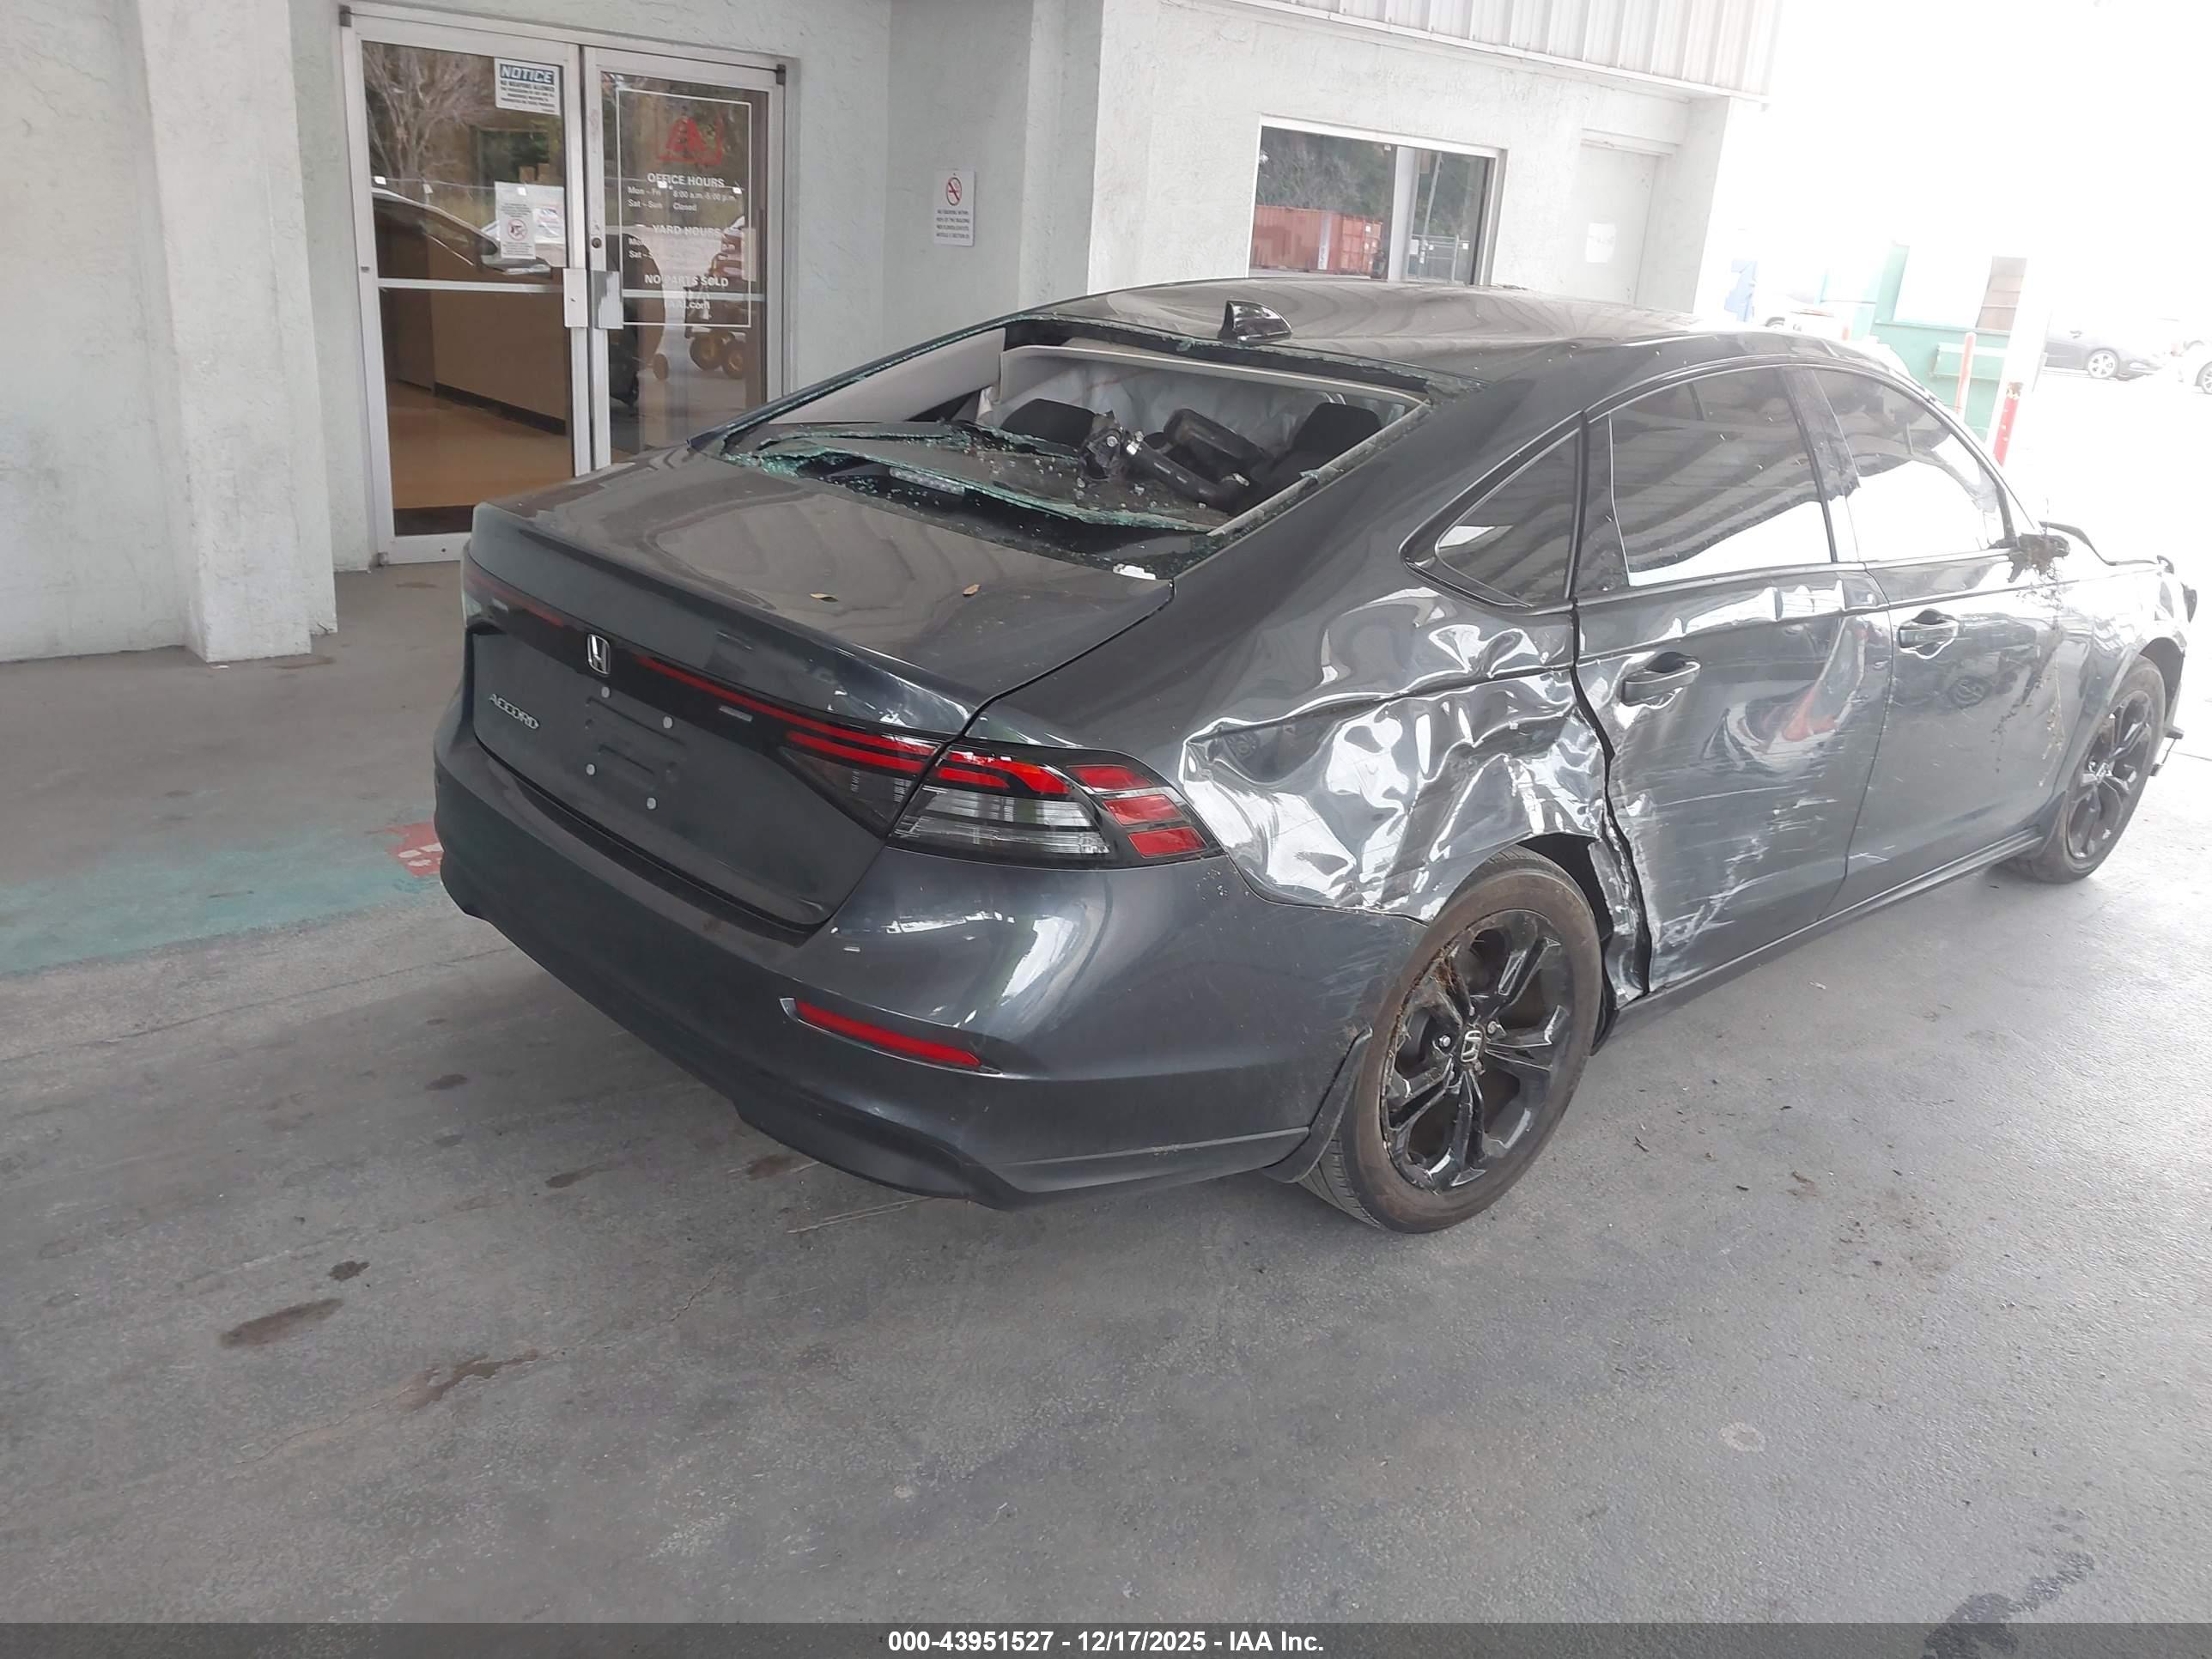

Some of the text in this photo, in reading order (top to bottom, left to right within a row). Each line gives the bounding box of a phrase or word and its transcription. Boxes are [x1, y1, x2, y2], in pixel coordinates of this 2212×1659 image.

[501, 64, 552, 82] NOTICE
[647, 173, 725, 187] OFFICE HOURS
[627, 185, 645, 195] Mon
[652, 187, 661, 196] Fri
[628, 198, 641, 208] Sat
[647, 200, 663, 210] Sun
[672, 202, 697, 211] Closed
[652, 224, 722, 236] YARD HOURS
[644, 274, 729, 287] NO PARTS SOLD
[489, 693, 539, 730] ACCORD
